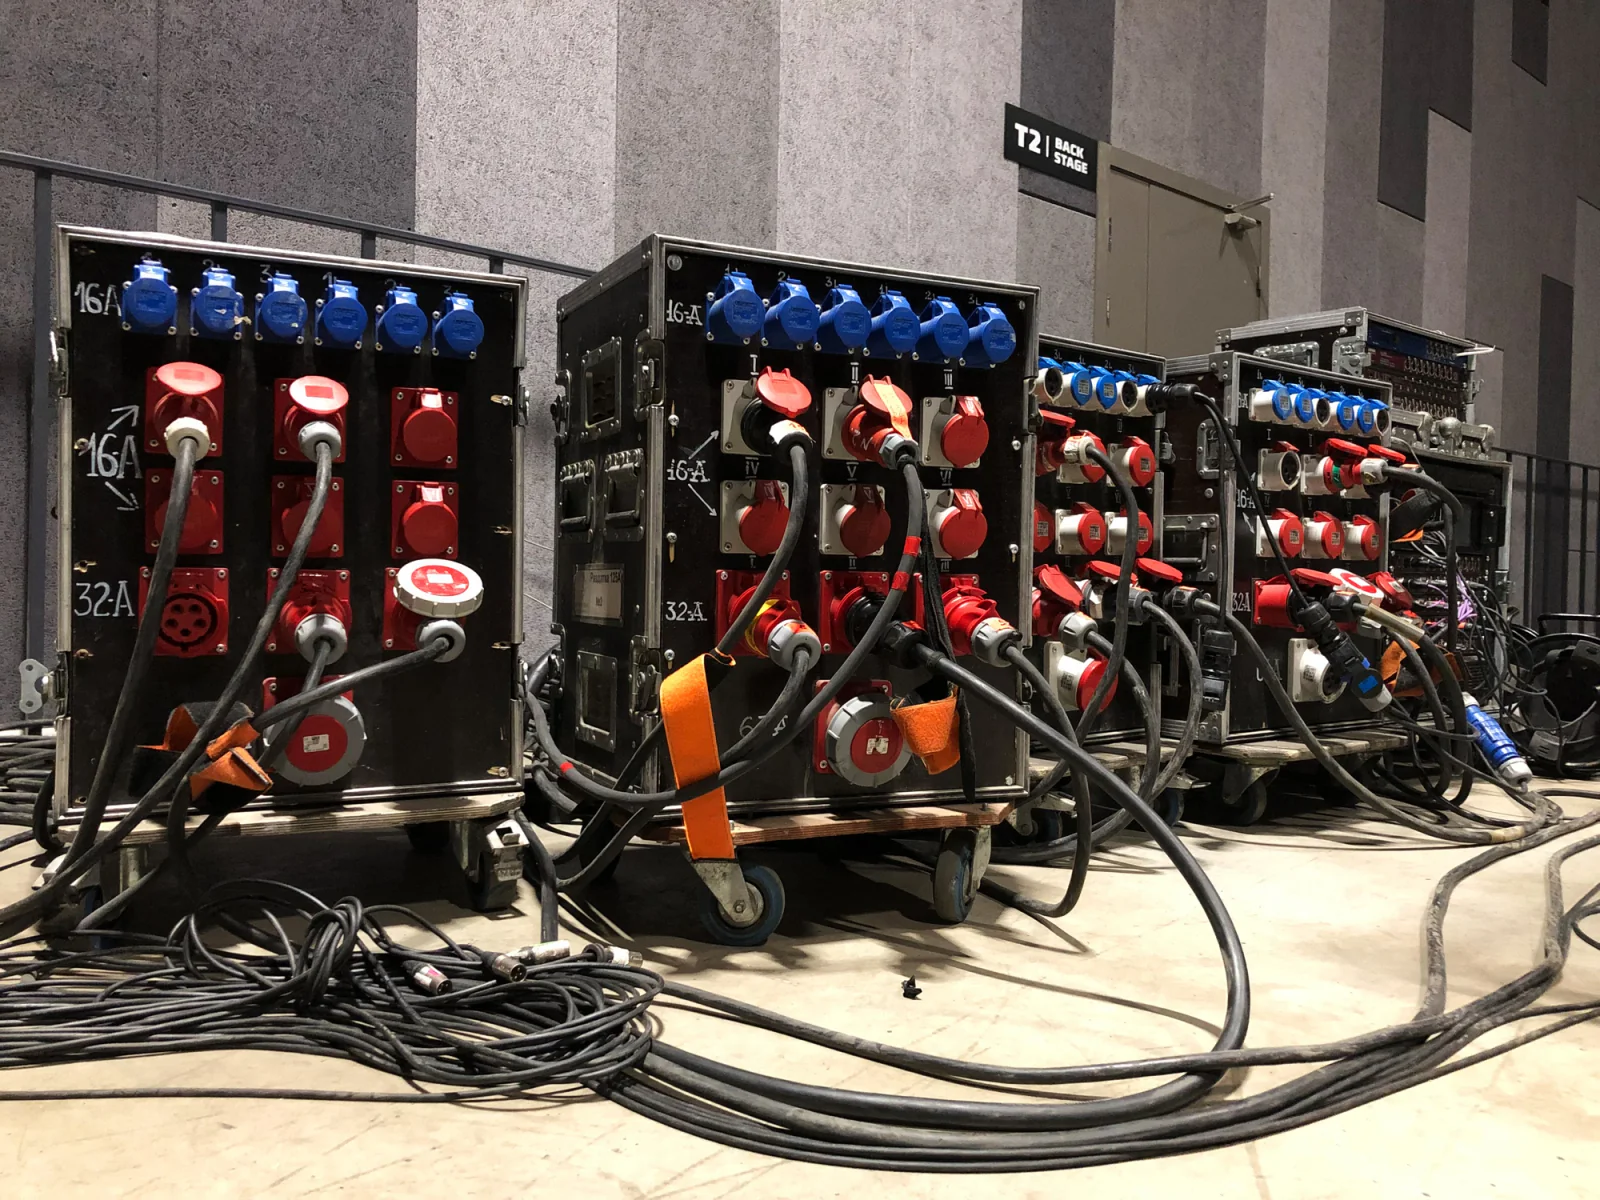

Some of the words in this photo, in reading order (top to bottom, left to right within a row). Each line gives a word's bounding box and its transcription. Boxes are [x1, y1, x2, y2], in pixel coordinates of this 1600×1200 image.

[1014, 122, 1041, 154] T2
[1054, 136, 1084, 160] BACK
[1053, 151, 1089, 175] STAGE
